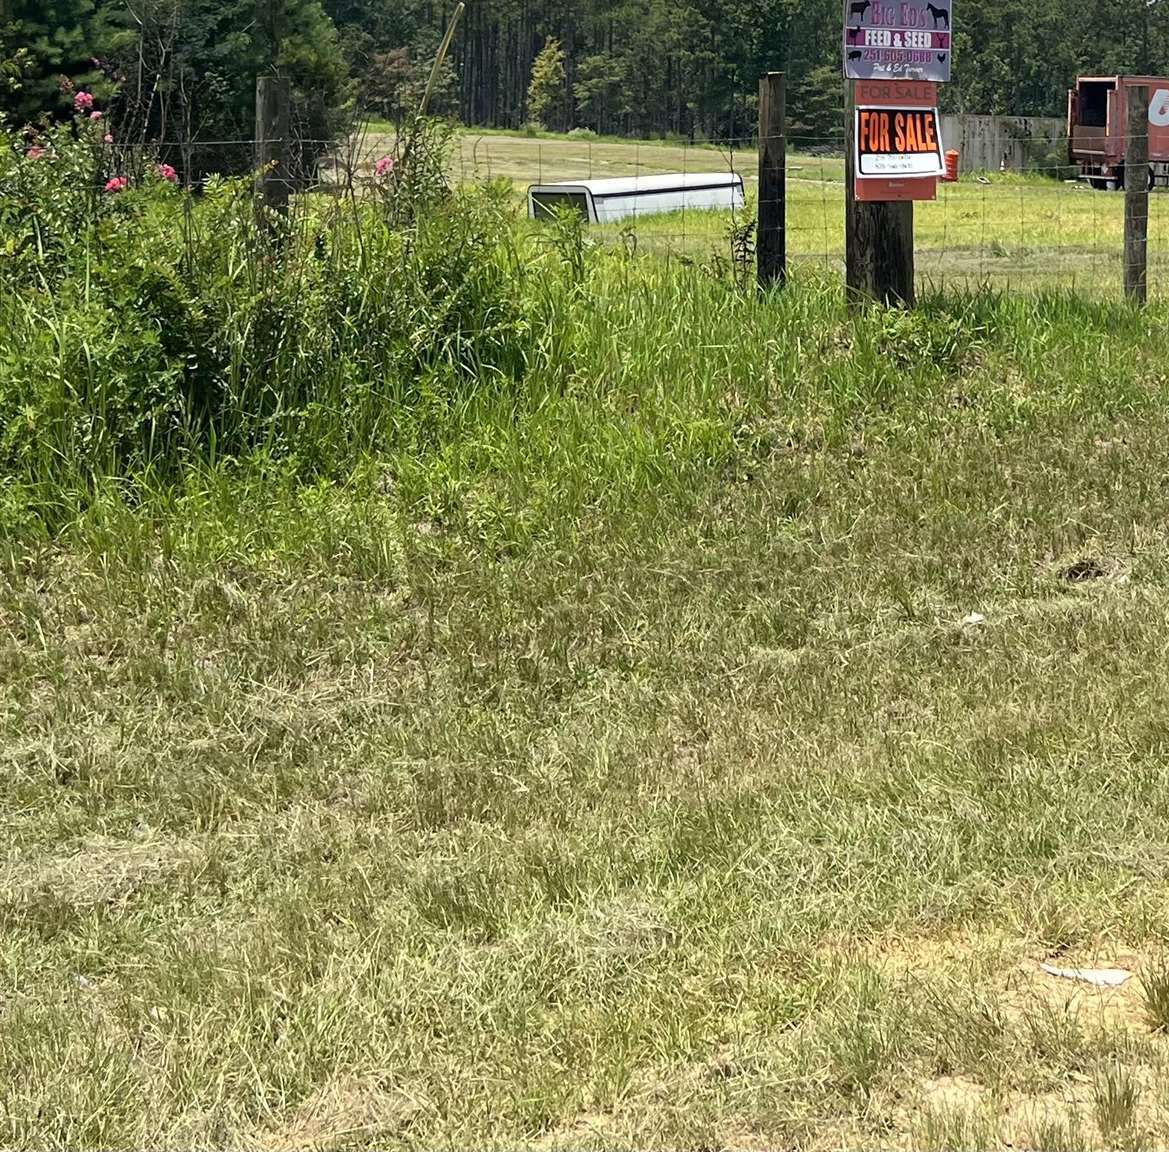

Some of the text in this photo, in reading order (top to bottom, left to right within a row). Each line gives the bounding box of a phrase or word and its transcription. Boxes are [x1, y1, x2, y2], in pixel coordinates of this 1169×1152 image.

[865, 29, 932, 48] FEED & SEED
[861, 88, 932, 99] FOR SALE
[860, 112, 937, 152] FOR SALE
